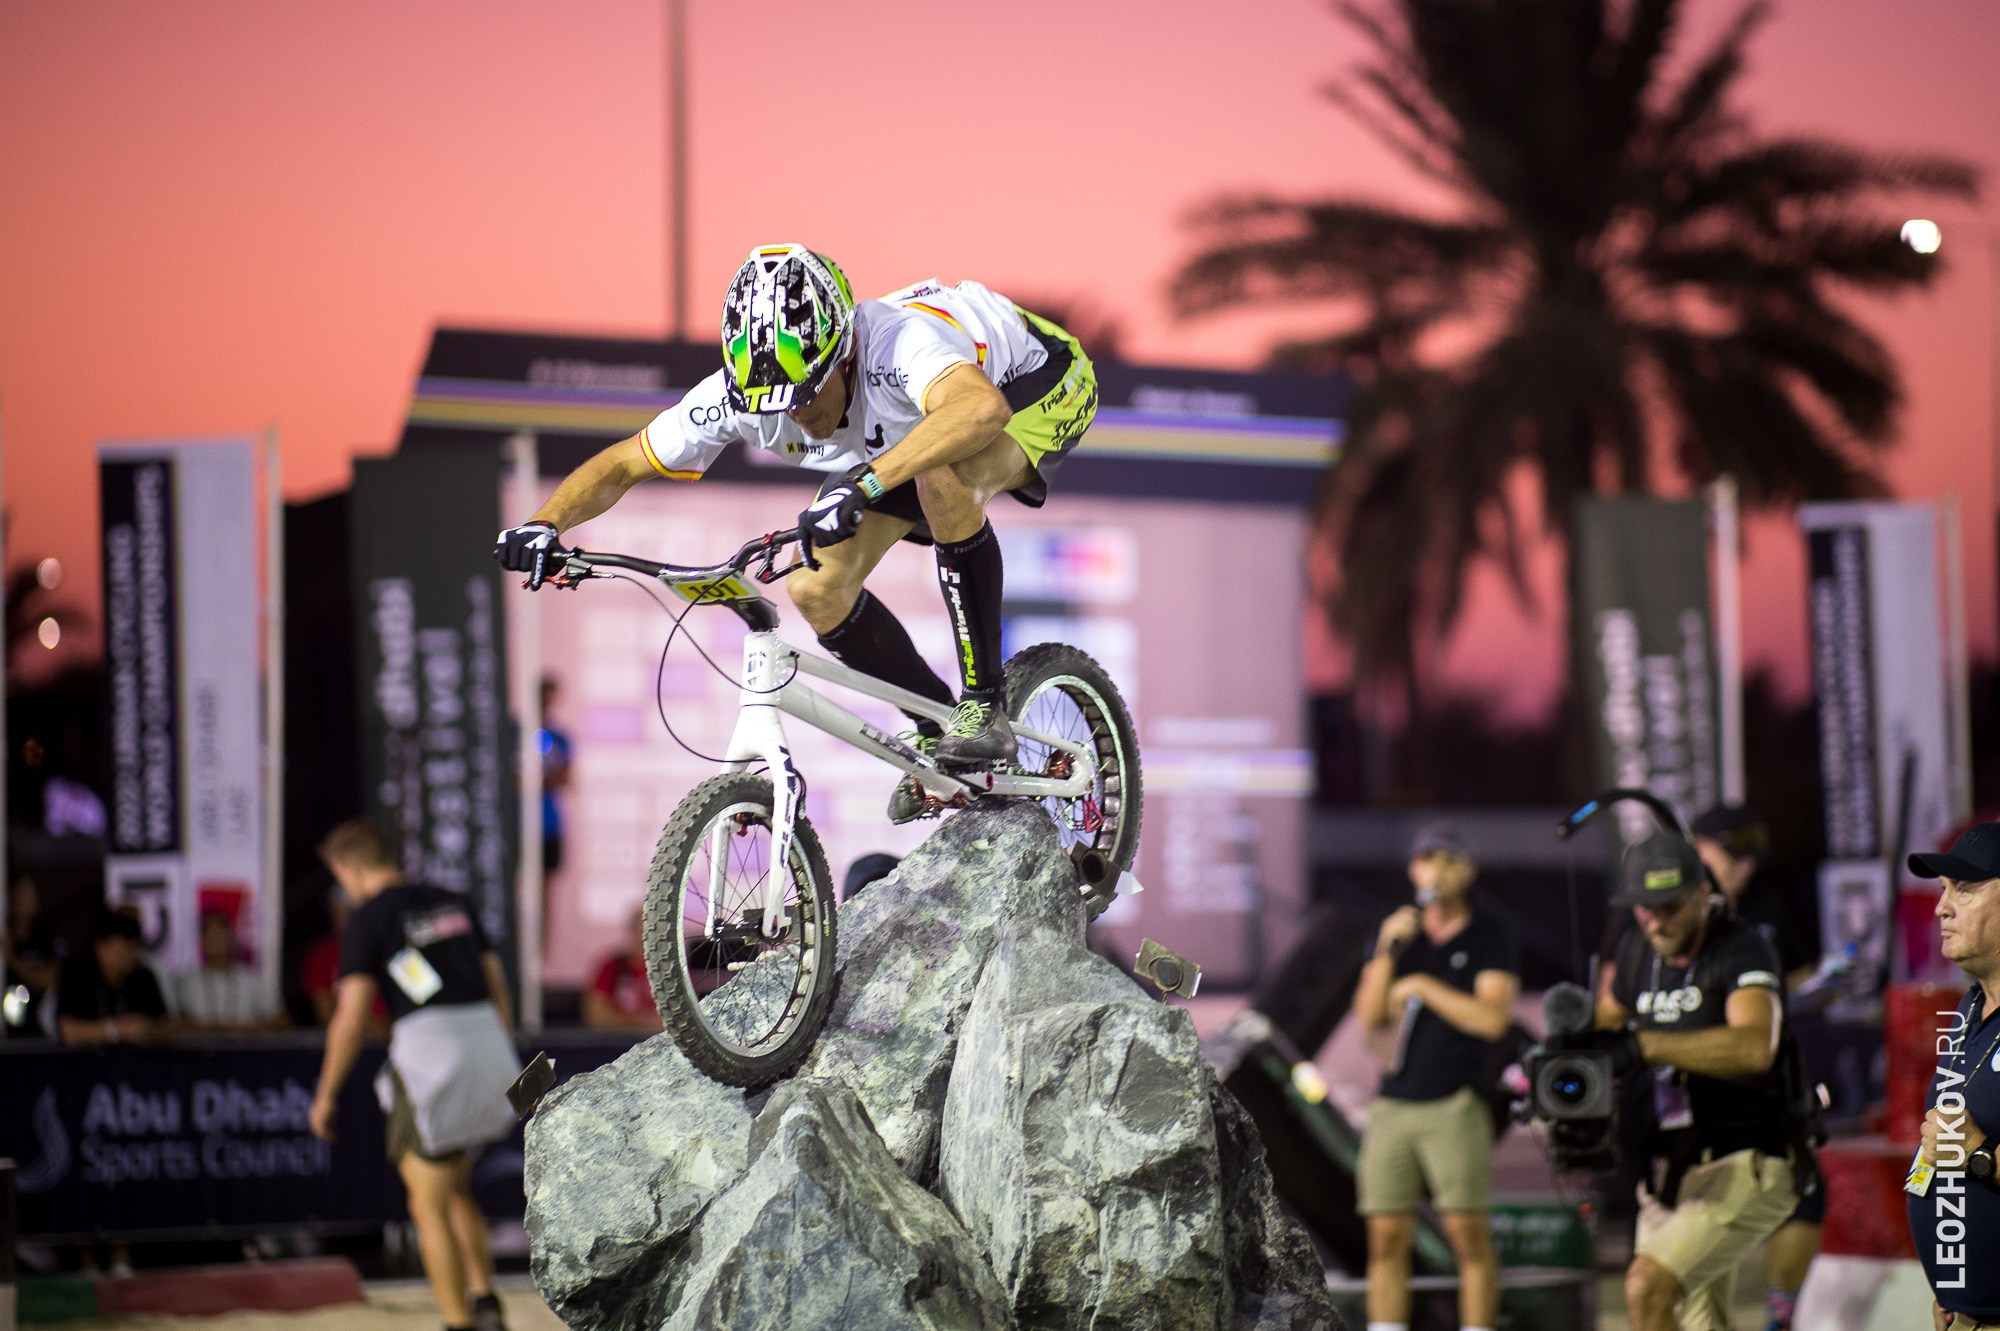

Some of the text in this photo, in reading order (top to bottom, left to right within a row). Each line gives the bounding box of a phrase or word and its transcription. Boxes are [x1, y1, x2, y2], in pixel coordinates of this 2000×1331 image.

[689, 396, 737, 427] Cof
[688, 582, 739, 599] 101
[83, 1077, 314, 1135] Abu Dhab
[82, 1133, 331, 1188] Sports Council
